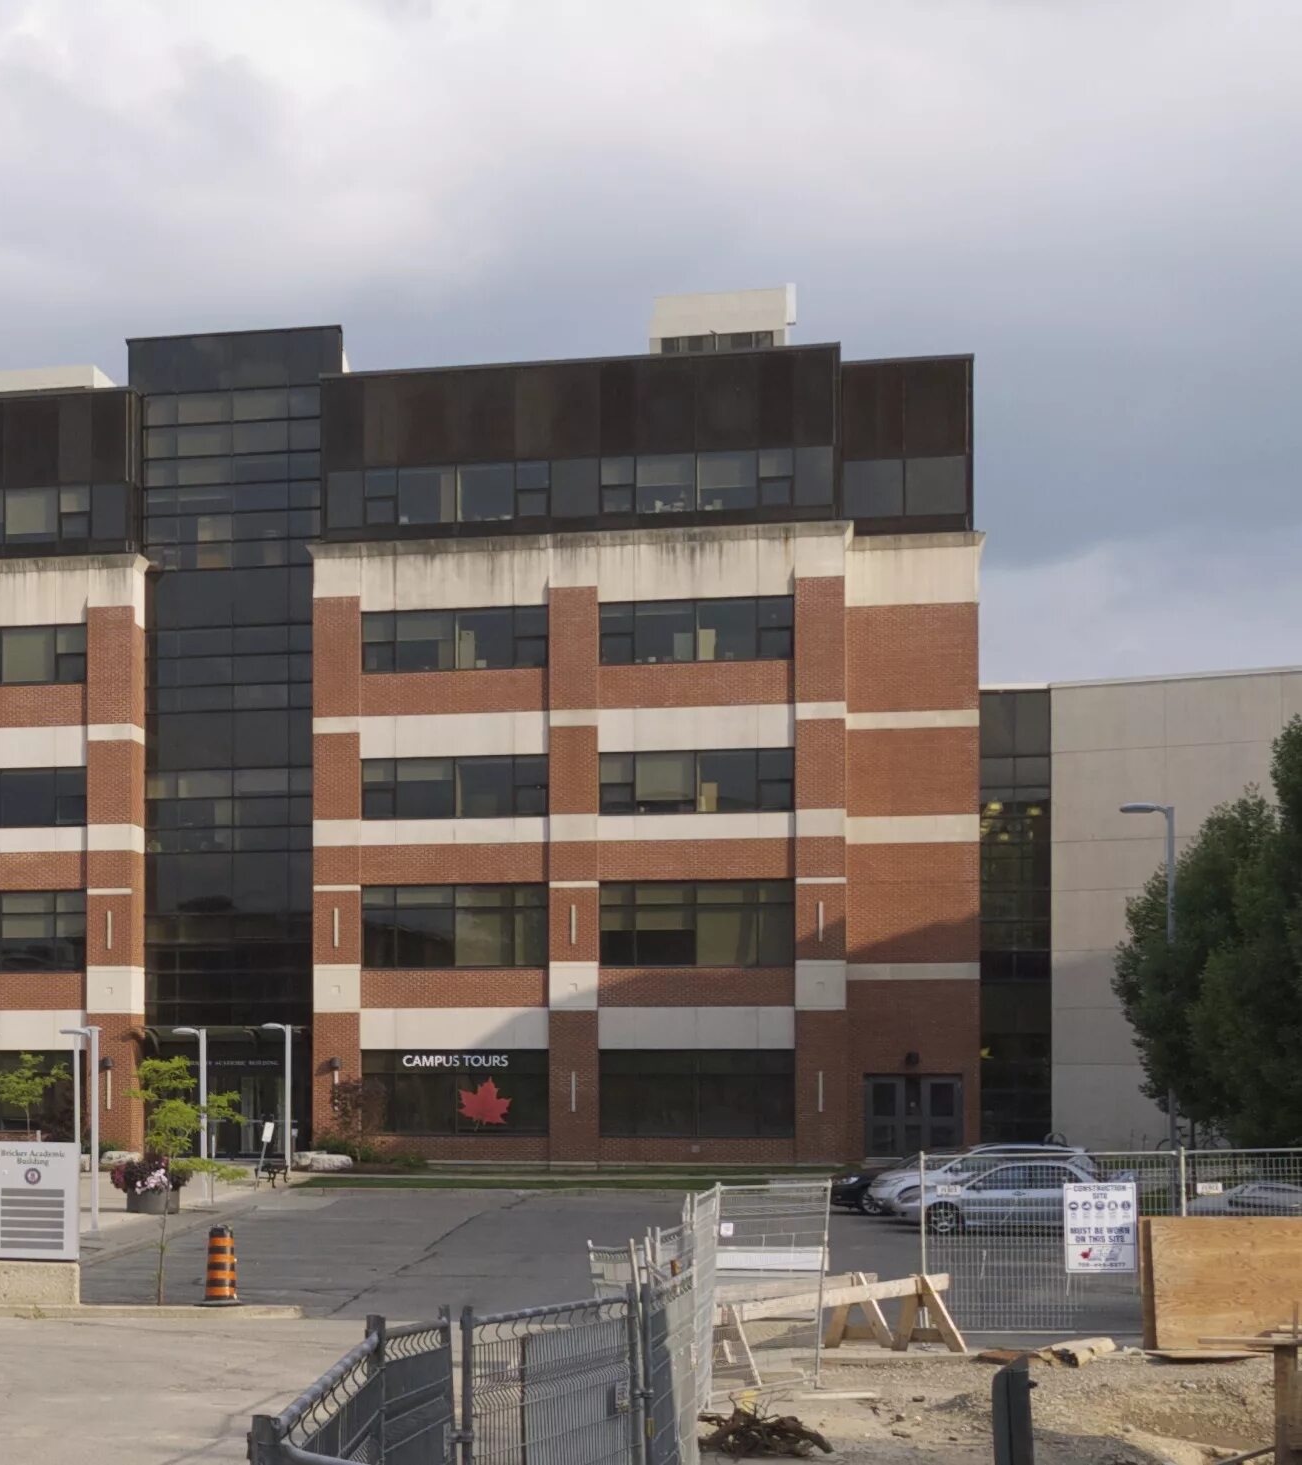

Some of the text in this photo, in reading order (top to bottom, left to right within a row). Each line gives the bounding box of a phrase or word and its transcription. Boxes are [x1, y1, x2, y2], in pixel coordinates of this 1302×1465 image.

[402, 1055, 509, 1067] CAMPUS TOURS
[30, 1149, 65, 1158] Academic
[17, 1158, 49, 1167] Building
[1106, 1227, 1130, 1235] WORN
[1108, 1235, 1125, 1243] SITE
